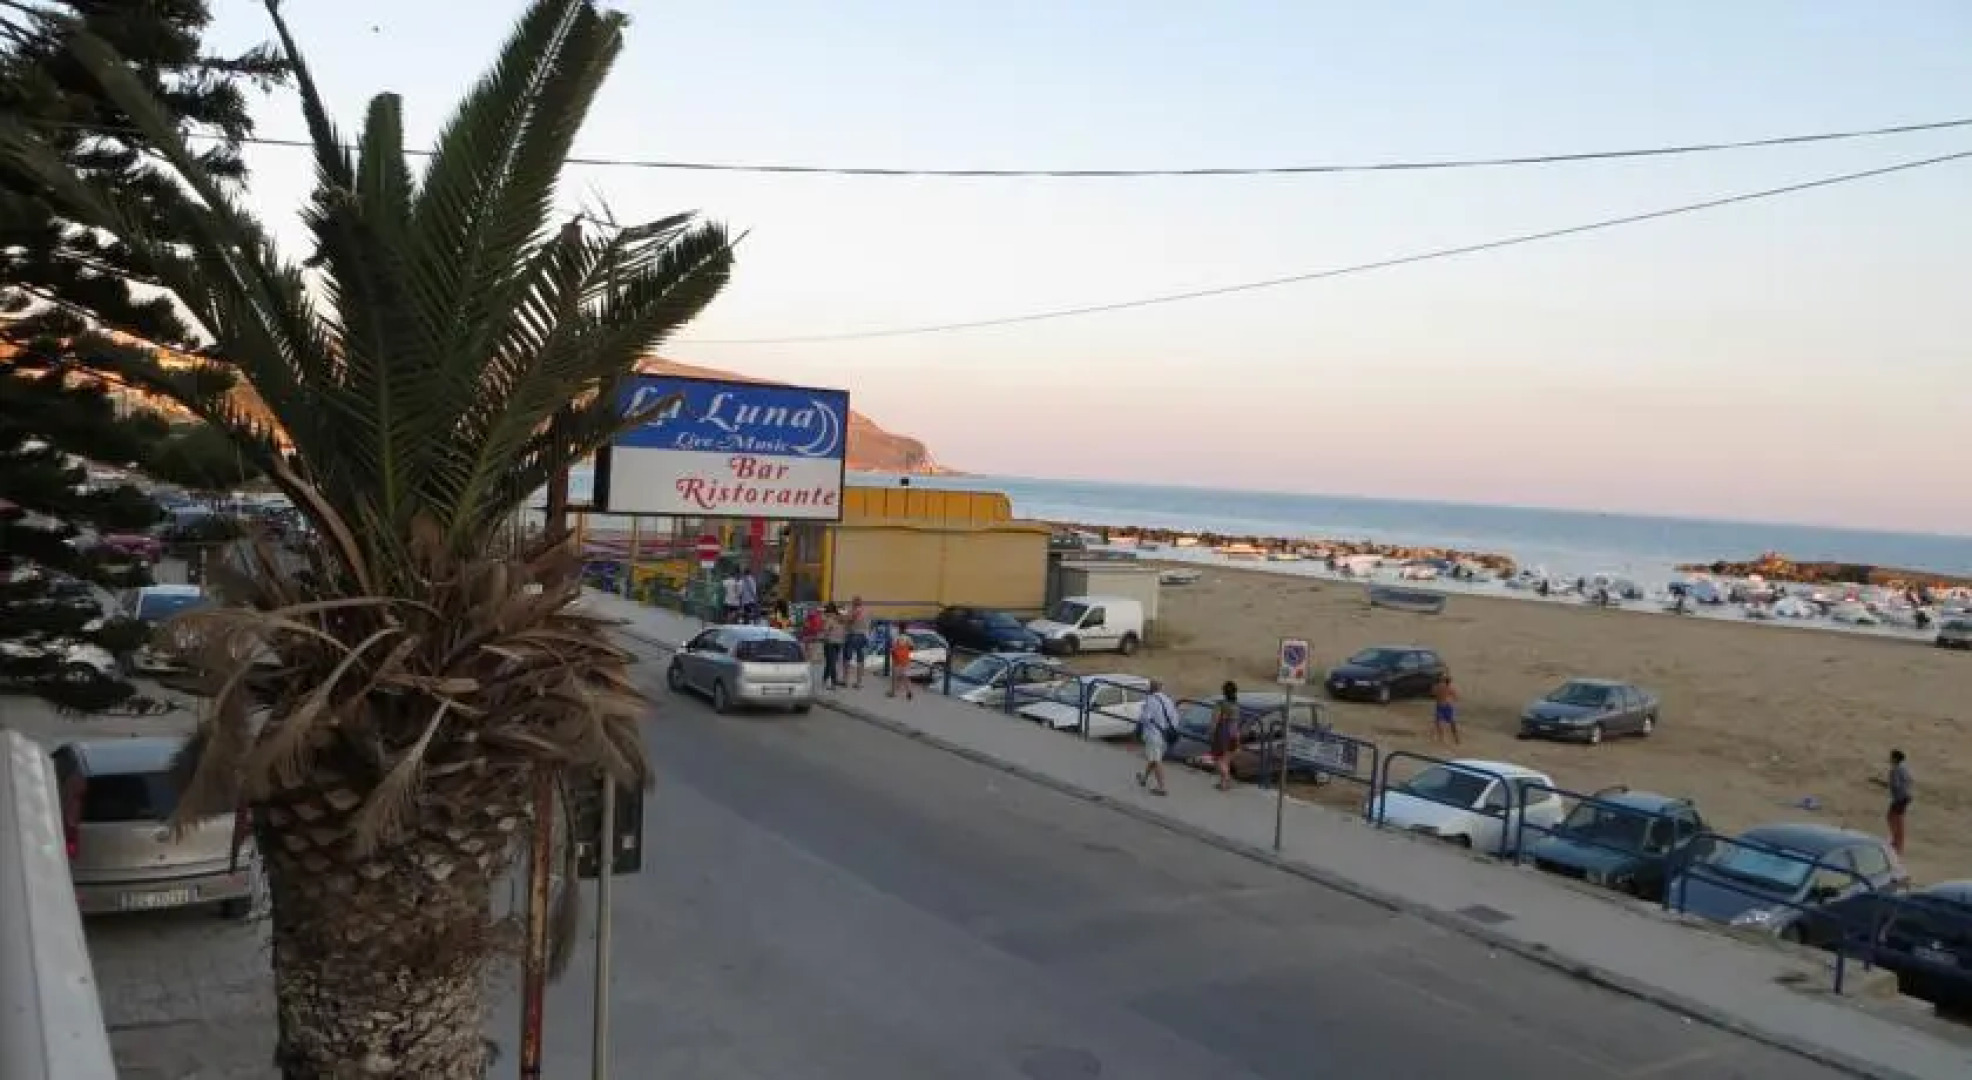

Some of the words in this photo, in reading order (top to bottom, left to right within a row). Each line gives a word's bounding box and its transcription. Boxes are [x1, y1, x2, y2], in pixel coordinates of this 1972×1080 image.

[698, 392, 813, 433] Luna
[730, 455, 790, 480] Bar
[675, 478, 837, 510] Ristorante
